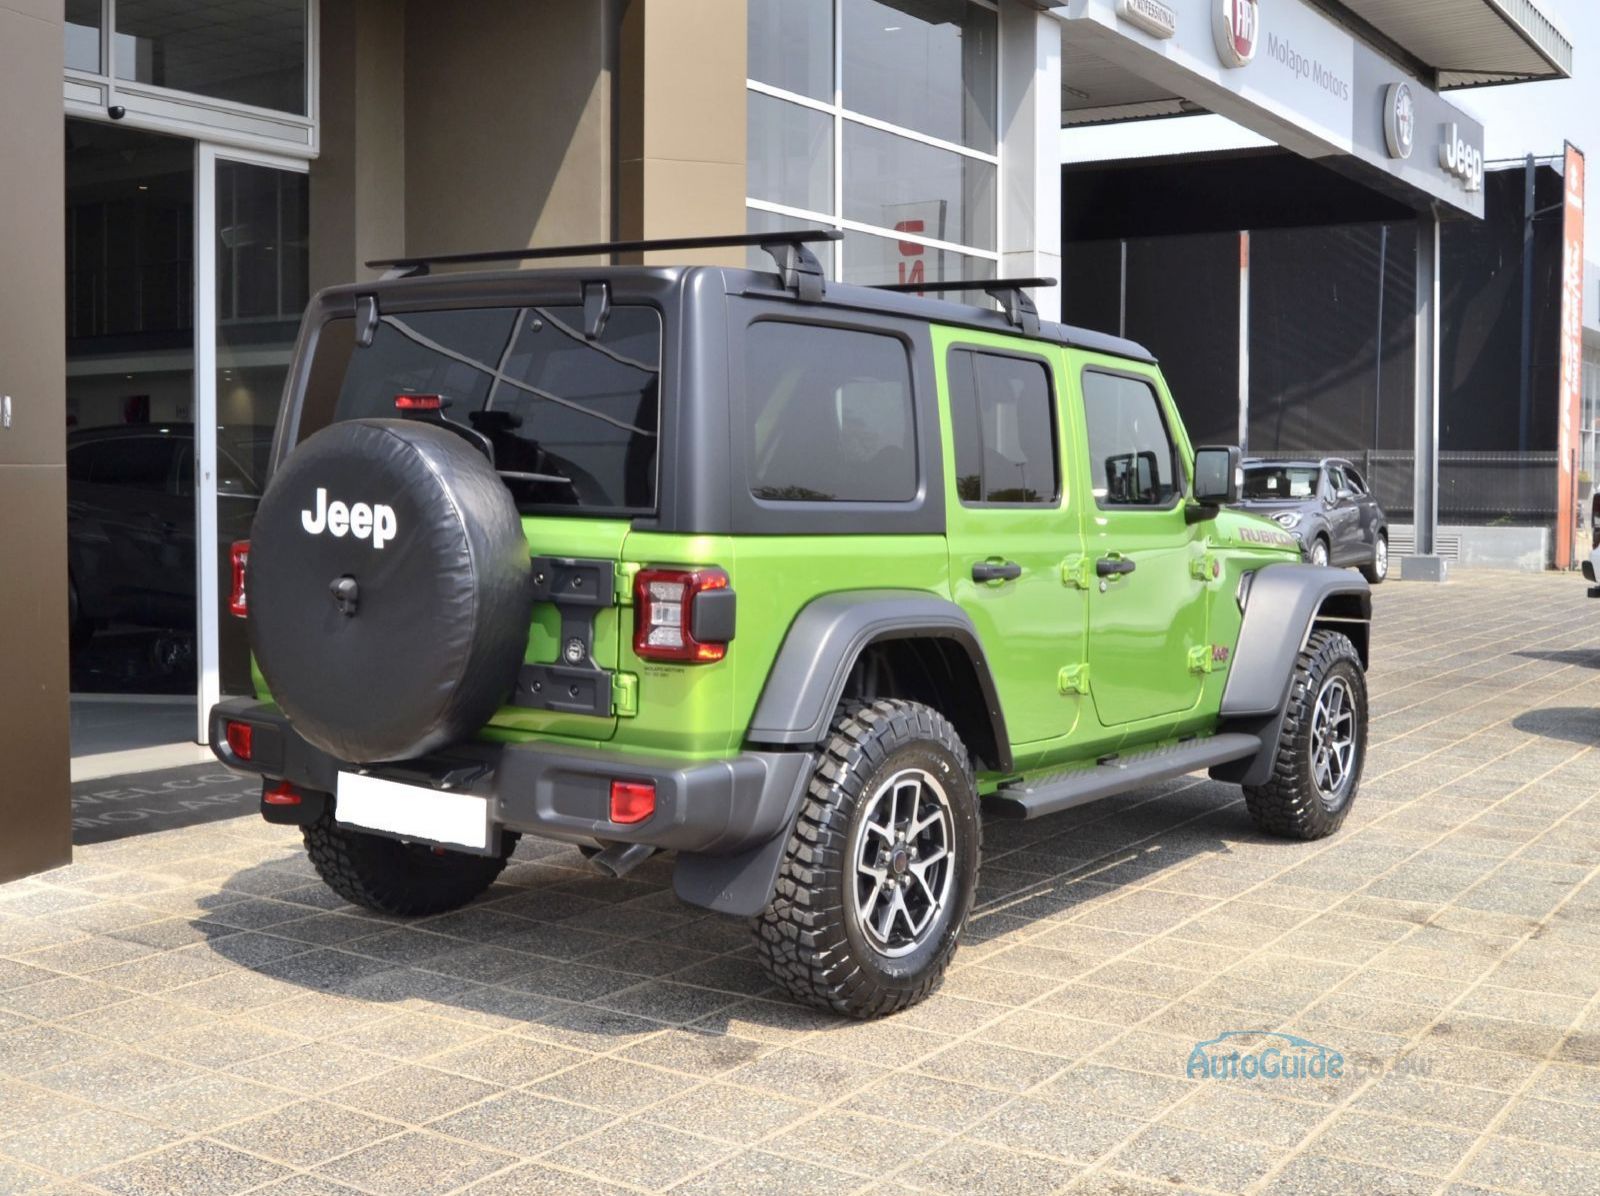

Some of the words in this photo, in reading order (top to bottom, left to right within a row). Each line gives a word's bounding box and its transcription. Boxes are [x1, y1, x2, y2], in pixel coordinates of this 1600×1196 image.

[1267, 31, 1310, 79] Molapo
[1312, 60, 1348, 101] Motors
[1446, 122, 1482, 190] Jeep
[301, 487, 397, 549] Jeep
